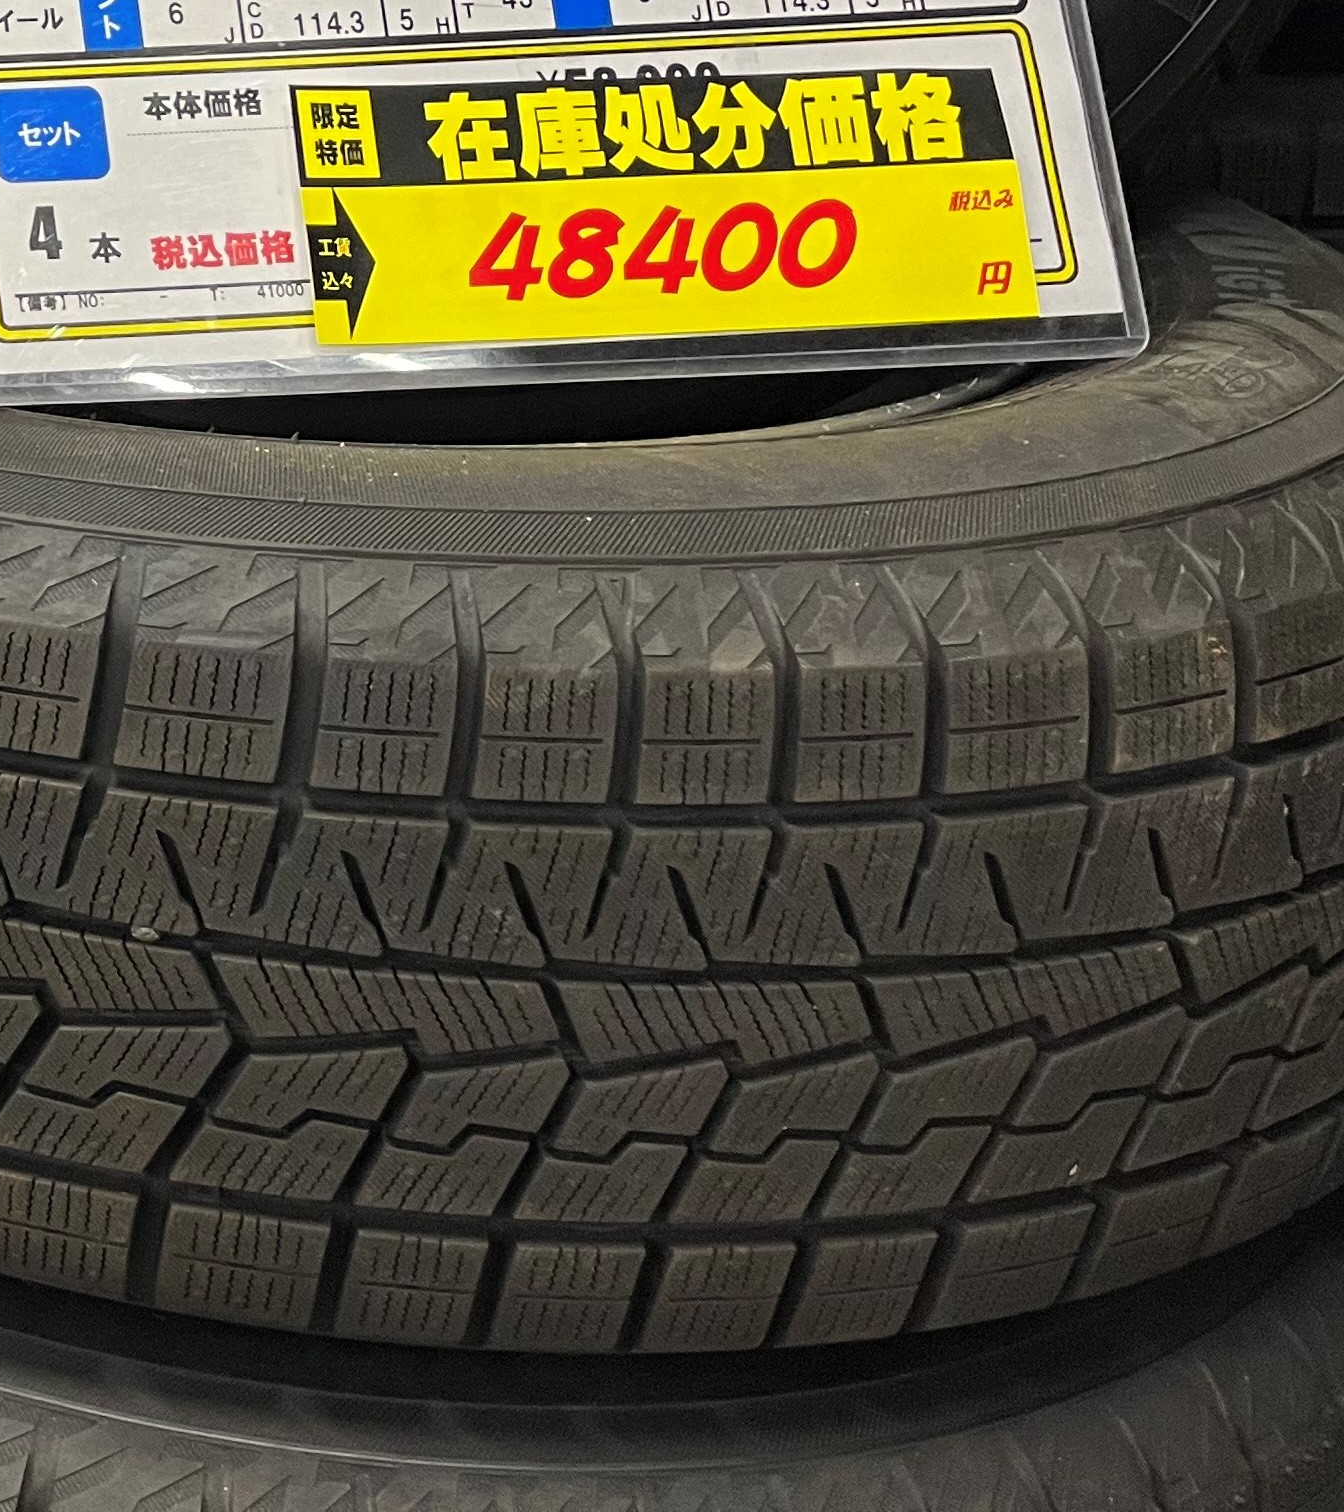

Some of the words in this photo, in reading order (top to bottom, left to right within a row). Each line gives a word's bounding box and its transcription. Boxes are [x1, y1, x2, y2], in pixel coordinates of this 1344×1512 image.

[167, 1, 184, 26] 6
[292, 10, 365, 38] 114.3
[399, 6, 413, 31] 5
[435, 15, 451, 34] H
[142, 87, 263, 121] 本体価格
[309, 100, 360, 130] 限定
[17, 119, 82, 148] セット
[423, 69, 964, 181] 在庫処分価格
[313, 137, 365, 168] 特価
[947, 188, 1014, 213] 税込み
[27, 204, 63, 261] 4
[88, 230, 122, 263] 本
[317, 236, 353, 260] 工賃
[150, 229, 295, 271] 税込価格
[467, 198, 857, 301] 48400
[256, 281, 305, 299] 41000
[976, 260, 1012, 295] 円
